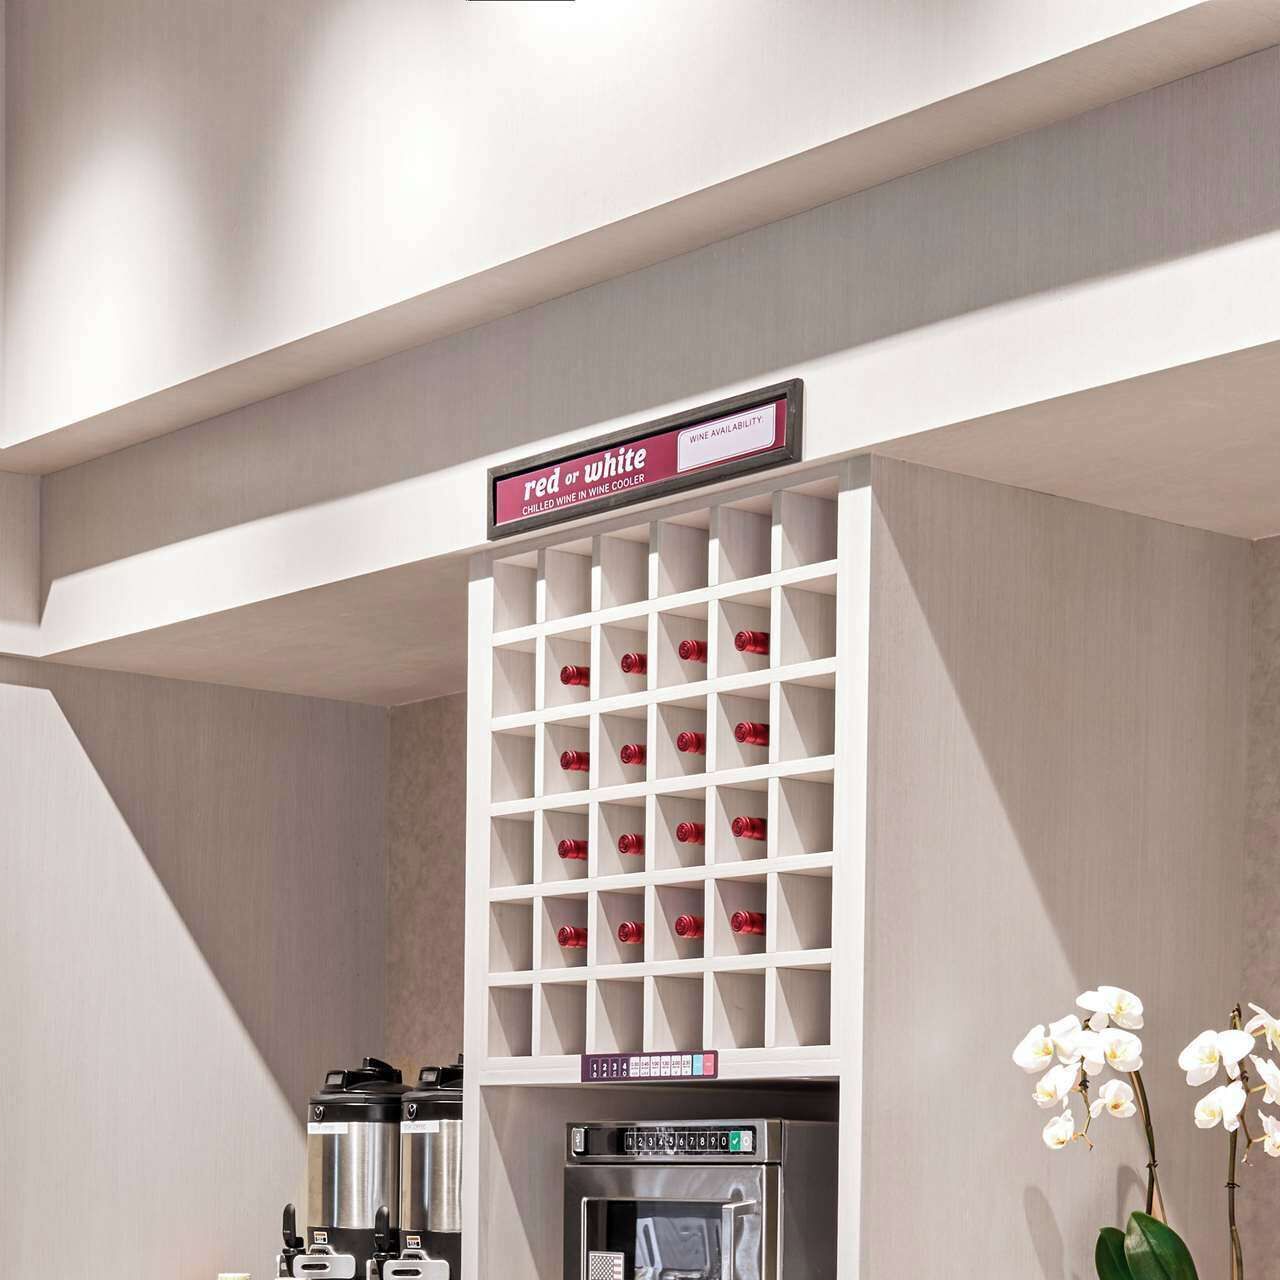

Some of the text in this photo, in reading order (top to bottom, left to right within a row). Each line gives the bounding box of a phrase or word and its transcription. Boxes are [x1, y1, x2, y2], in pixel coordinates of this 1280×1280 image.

[689, 432, 709, 443] WINE
[524, 447, 647, 500] red or white
[522, 473, 645, 515] CHILLED WINE IN WINE COOLER
[628, 1137, 633, 1146] 1
[638, 1137, 643, 1146] 2
[648, 1137, 654, 1146] 3
[658, 1137, 664, 1146] 4
[669, 1137, 674, 1146] 5
[679, 1137, 684, 1146] 6
[689, 1137, 695, 1146] 7
[700, 1137, 705, 1146] 8
[710, 1137, 715, 1146] 9
[721, 1137, 727, 1146] 0
